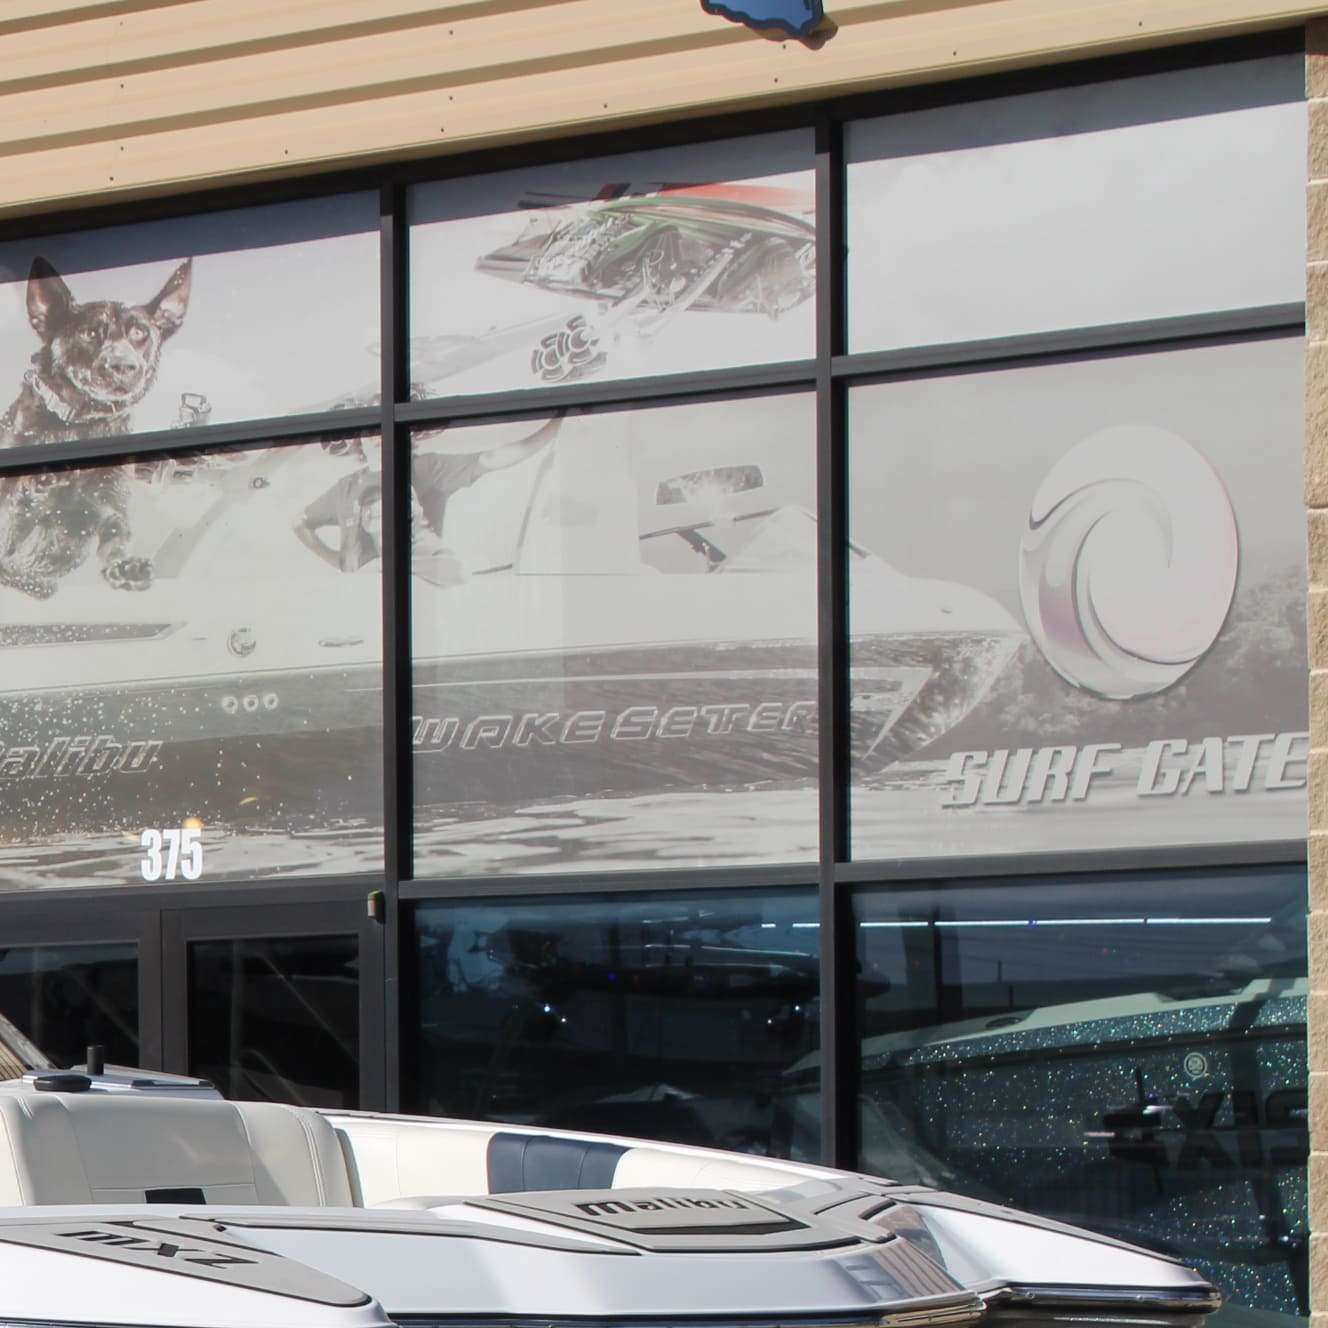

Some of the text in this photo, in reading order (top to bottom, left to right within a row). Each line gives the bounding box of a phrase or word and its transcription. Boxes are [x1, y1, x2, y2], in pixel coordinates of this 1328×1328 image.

[942, 732, 1310, 807] SURF GATE
[140, 828, 204, 881] 375
